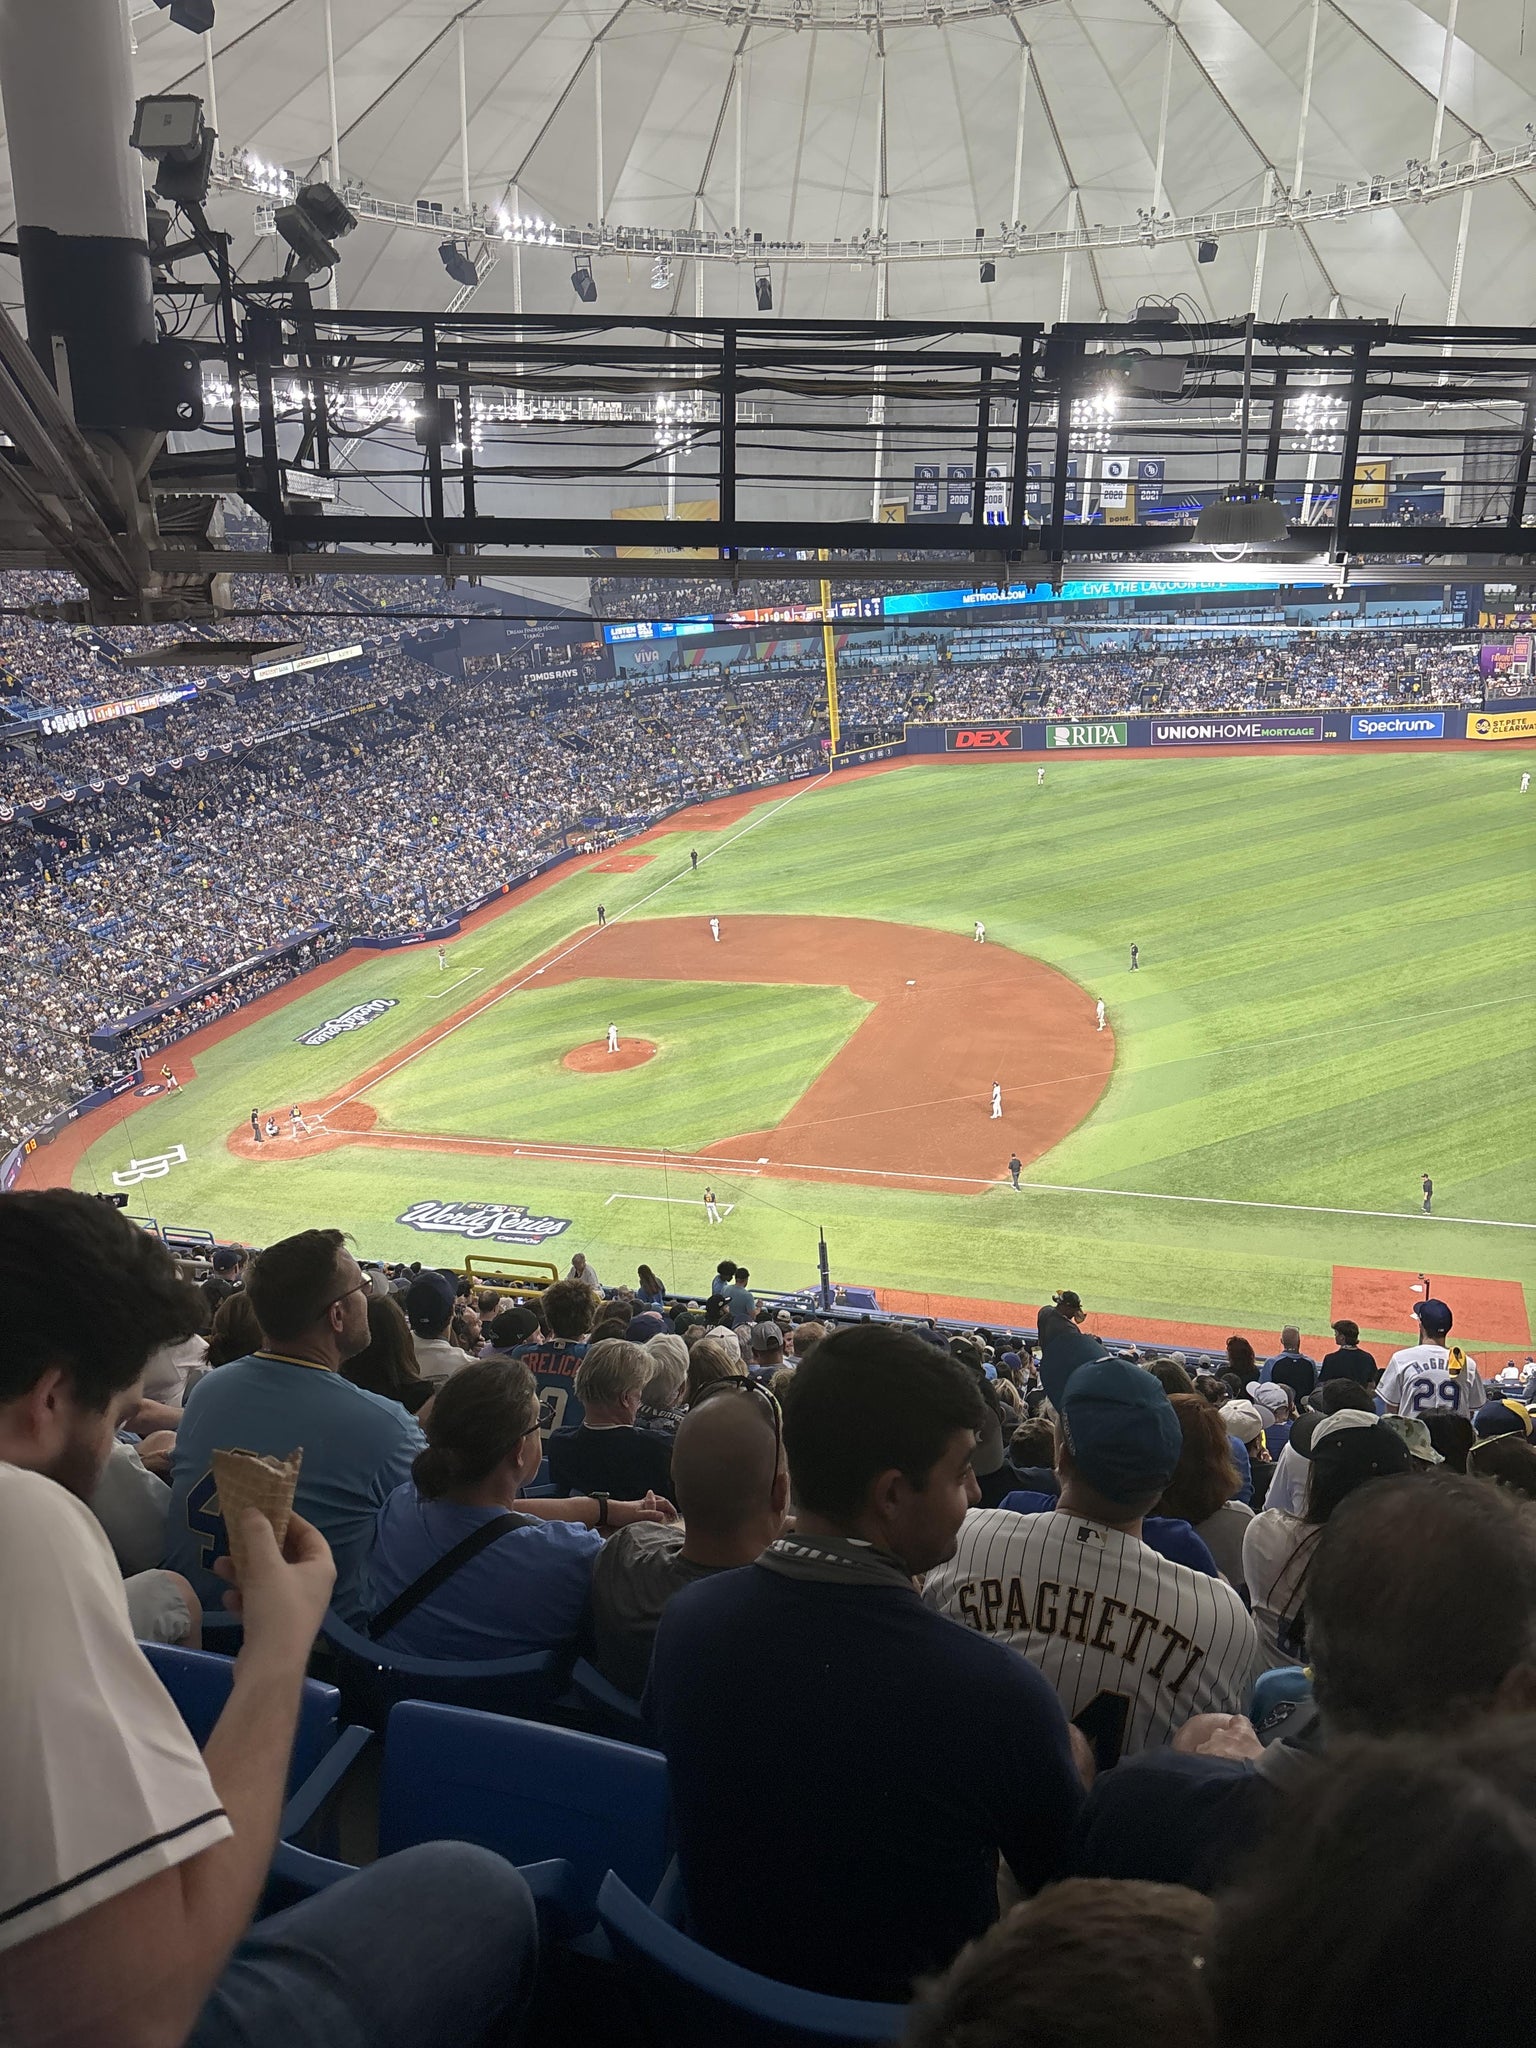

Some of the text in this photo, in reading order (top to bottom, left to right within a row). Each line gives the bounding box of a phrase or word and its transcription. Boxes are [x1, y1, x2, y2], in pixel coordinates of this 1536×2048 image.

[950, 495, 969, 505] 2008
[1104, 490, 1123, 499] 2020
[1141, 491, 1159, 500] 2021
[1354, 497, 1381, 505] RIGHT.
[1109, 515, 1131, 523] DONE.
[1083, 583, 1110, 595] LIVE
[1114, 582, 1138, 593] THE
[634, 651, 659, 662] VIVA
[555, 669, 578, 678] RAYS
[1358, 718, 1430, 735] Spectrum
[1072, 725, 1120, 745] RIPA
[1261, 728, 1315, 737] MORTGAGE
[955, 730, 1012, 748] DEX
[68, 1109, 79, 1120] FOX
[401, 1202, 567, 1237] World Series
[1413, 1378, 1460, 1412] 29
[958, 1577, 1204, 1694] SPAGHETTI
